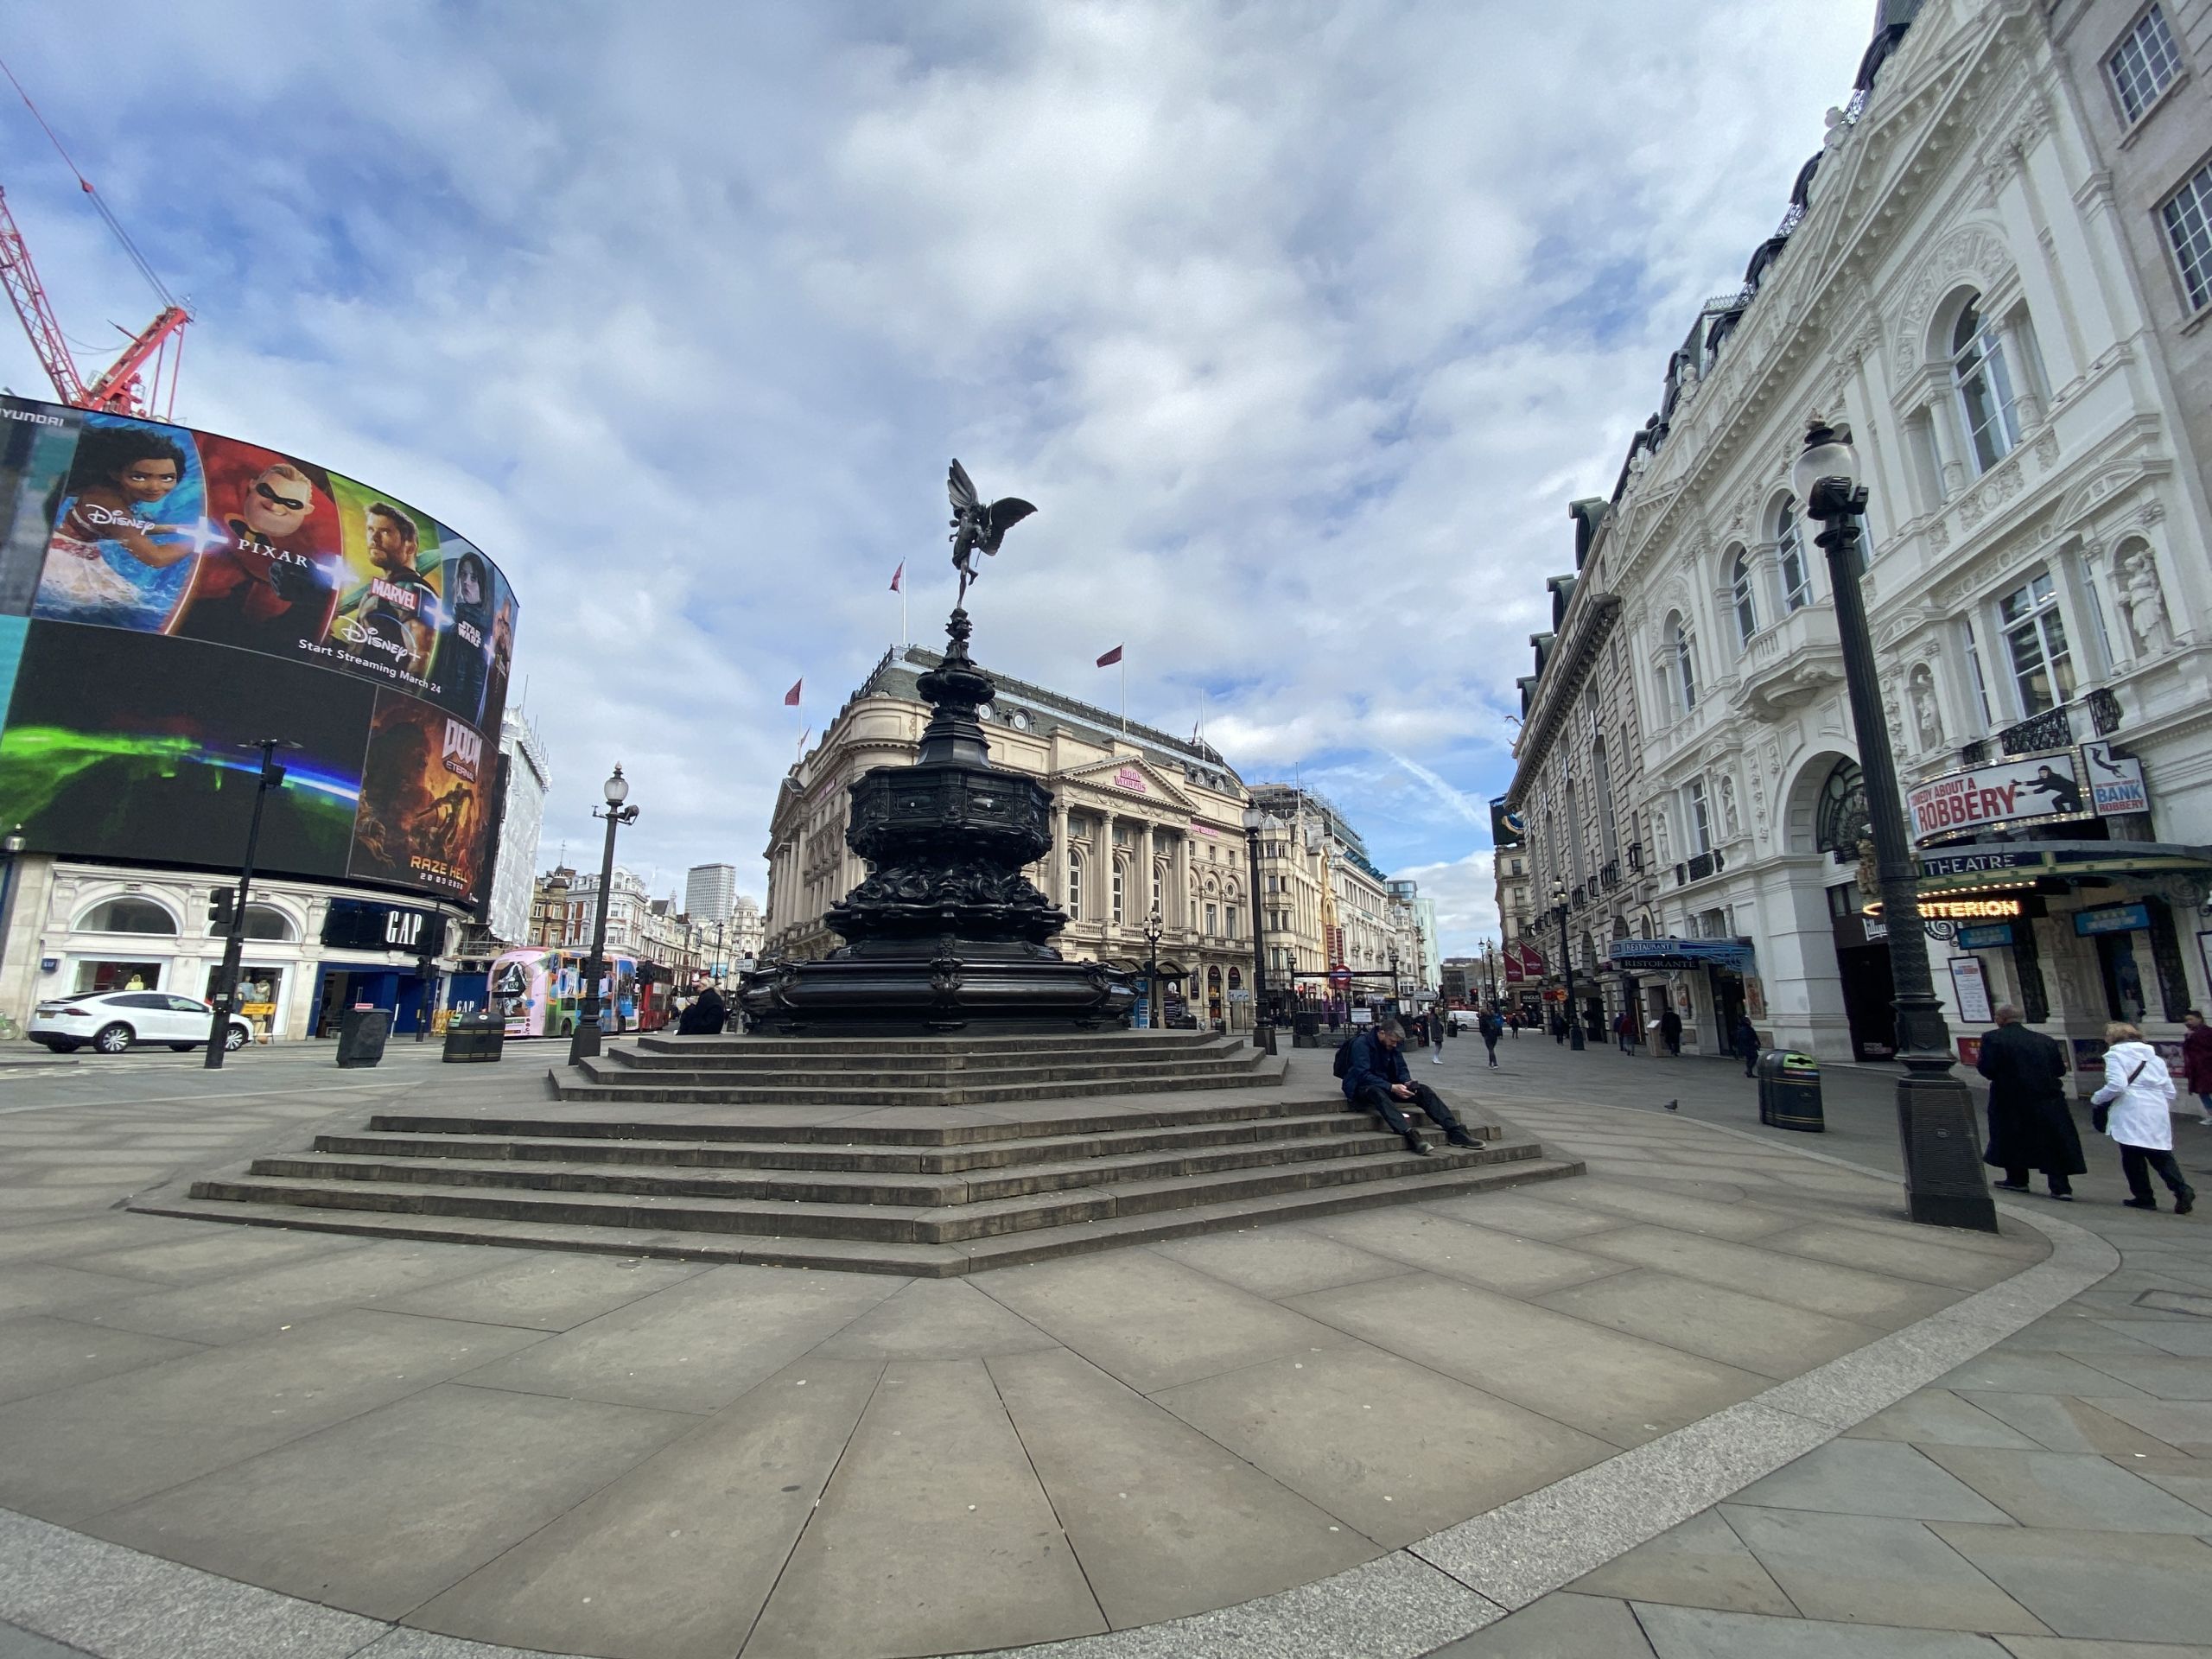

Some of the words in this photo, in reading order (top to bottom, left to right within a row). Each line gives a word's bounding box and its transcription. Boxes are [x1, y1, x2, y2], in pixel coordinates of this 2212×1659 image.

[0, 409, 64, 427] YUNDAI
[237, 538, 308, 568] PIXAR
[372, 577, 416, 610] MARVEL
[458, 620, 481, 638] STAR
[458, 626, 482, 648] WARS
[298, 639, 333, 657] Start
[336, 649, 397, 678] Streaming
[399, 670, 429, 689] March
[430, 683, 442, 694] 24
[442, 718, 483, 776] DOOM
[446, 760, 475, 782] ETERNAL
[1121, 768, 1142, 781] BODY
[1115, 777, 1147, 792] WORLDS
[1935, 779, 1964, 798] ABOUT
[1967, 777, 1976, 790] A
[2095, 784, 2143, 804] BANK
[1917, 784, 2016, 832] ROBBERY
[2098, 799, 2144, 812] ROBBERY
[410, 855, 448, 875] RAZE
[449, 865, 468, 883] HELL
[1925, 855, 2016, 876] THEATRE
[1917, 900, 2020, 918] RITERION
[385, 910, 423, 945] GAP
[1625, 942, 1671, 952] RESTAURANT
[1624, 959, 1697, 969] RISTORANTE
[456, 1001, 475, 1014] GAP
